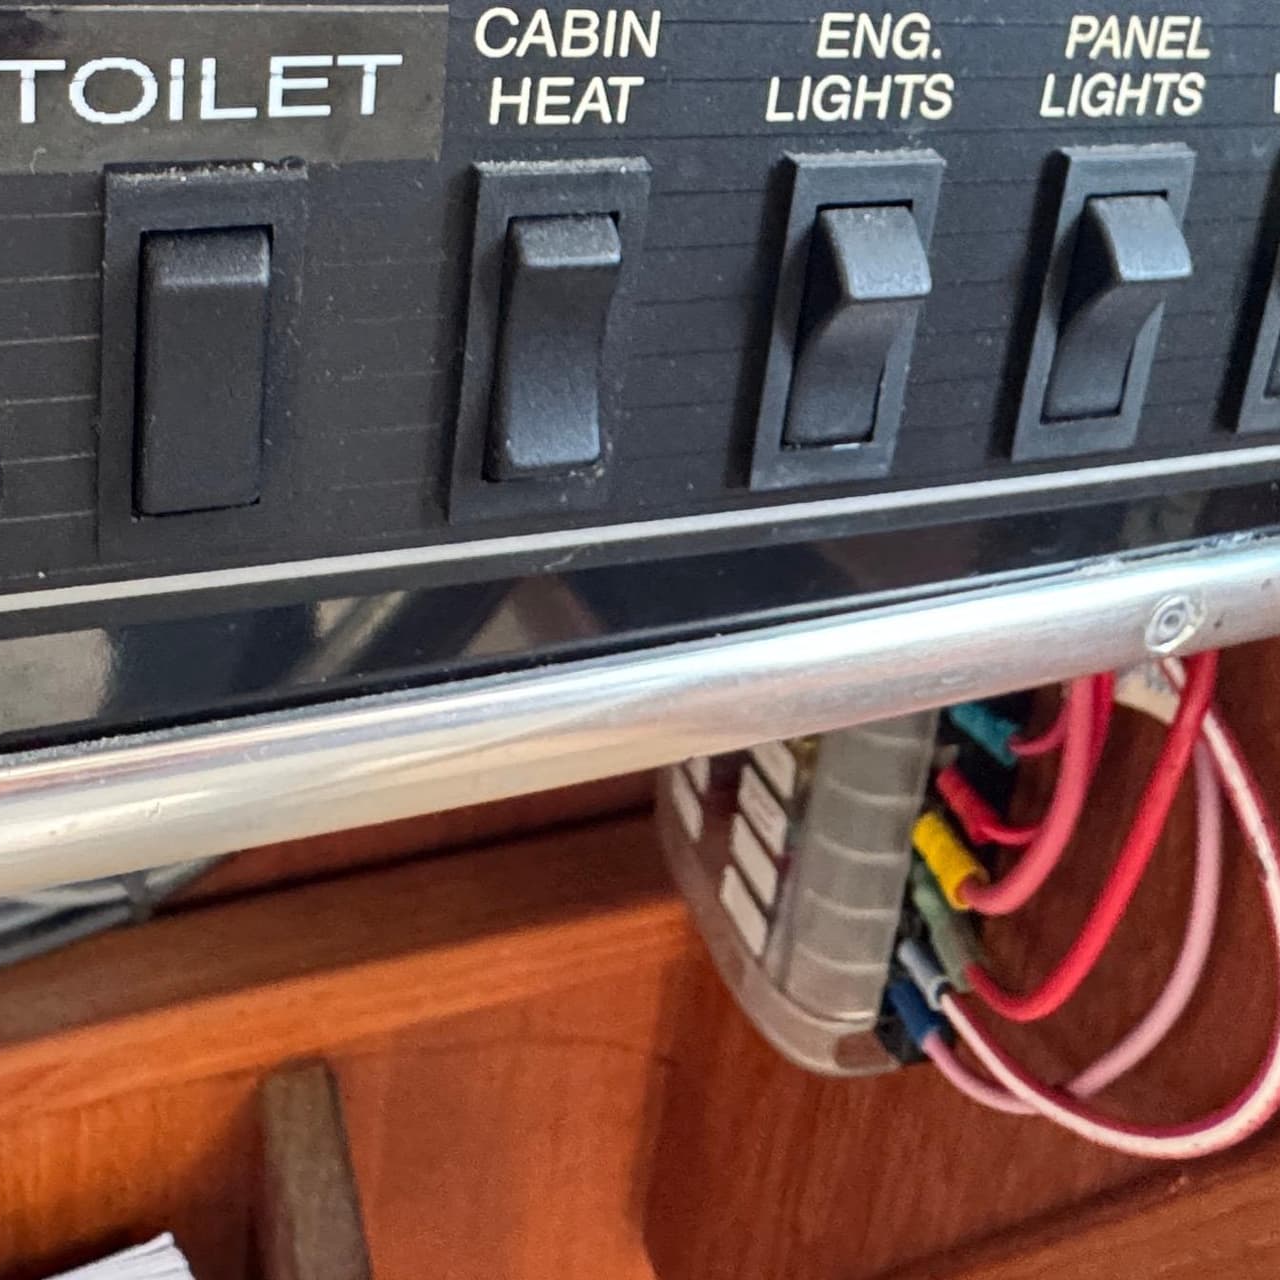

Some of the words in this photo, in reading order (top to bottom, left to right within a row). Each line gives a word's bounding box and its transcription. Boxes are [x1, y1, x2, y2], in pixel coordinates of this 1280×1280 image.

[474, 7, 661, 59] CABIN
[817, 13, 943, 60] ENG.
[1065, 15, 1210, 59] PANEL
[488, 76, 645, 125] HEAT
[765, 73, 955, 122] LIGHTS
[1040, 71, 1206, 118] LIGHTS
